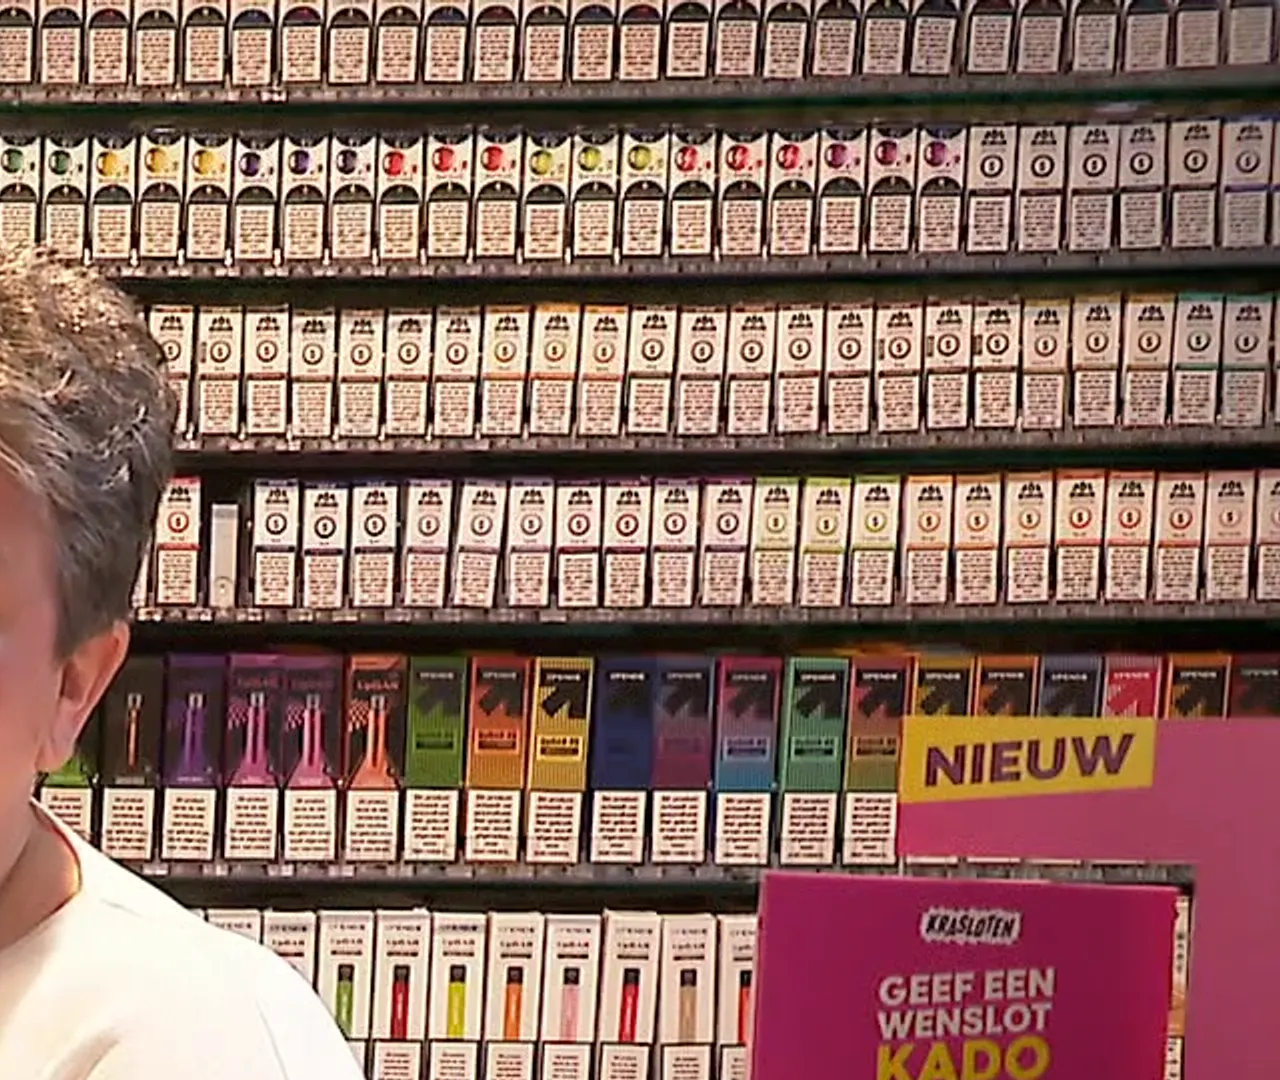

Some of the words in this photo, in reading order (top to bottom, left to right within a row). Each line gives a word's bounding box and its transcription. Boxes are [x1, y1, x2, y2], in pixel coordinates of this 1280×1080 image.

[924, 734, 1135, 787] NIEUW
[925, 910, 1015, 939] KRASLOTEN
[878, 973, 973, 1007] GEEF
[984, 968, 1056, 1000] EEN
[878, 1004, 1052, 1041] WENSLOT
